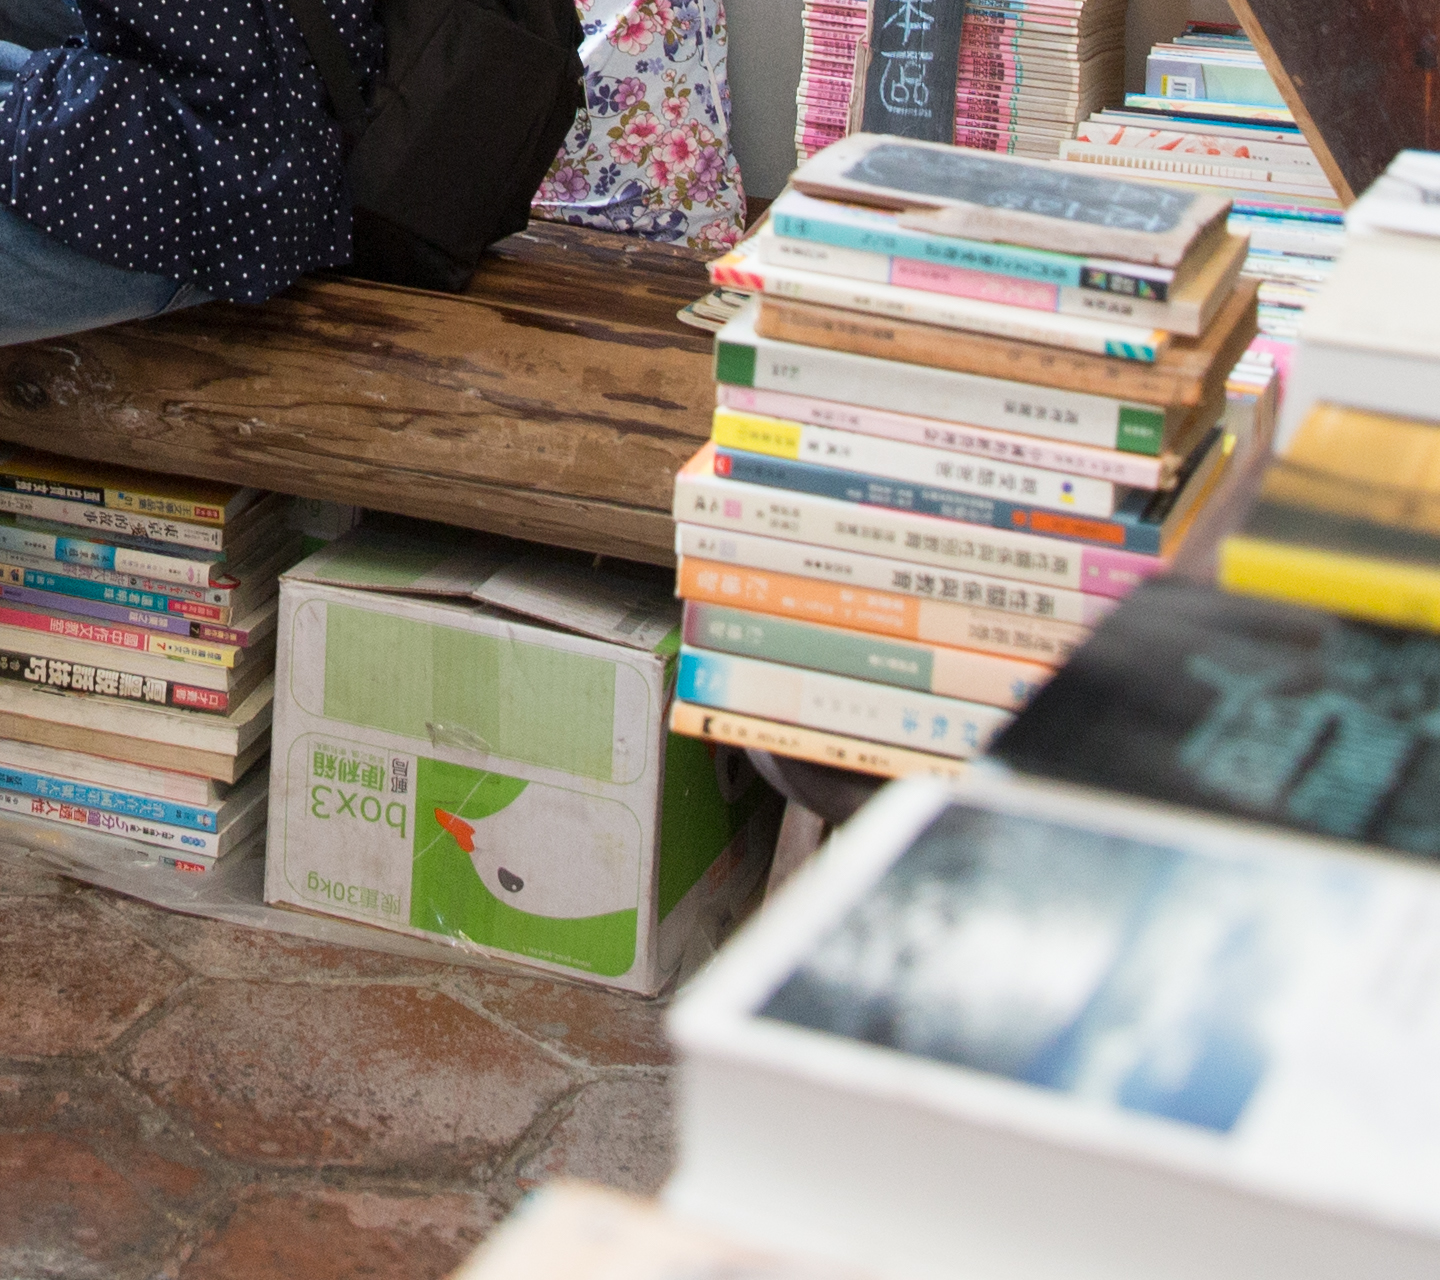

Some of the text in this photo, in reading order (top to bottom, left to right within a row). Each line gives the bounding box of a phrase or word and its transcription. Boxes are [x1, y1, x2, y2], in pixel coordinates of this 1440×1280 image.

[82, 509, 180, 539] 東京愛的故事
[49, 616, 141, 649] 國中作文教室
[23, 655, 167, 704] 厚黑說話技巧
[312, 750, 386, 794] 便利箱
[391, 757, 410, 796] 郵局
[30, 797, 129, 834] 5分鐘看透人性
[309, 784, 408, 839] box3
[307, 870, 402, 918] 限重30kg
